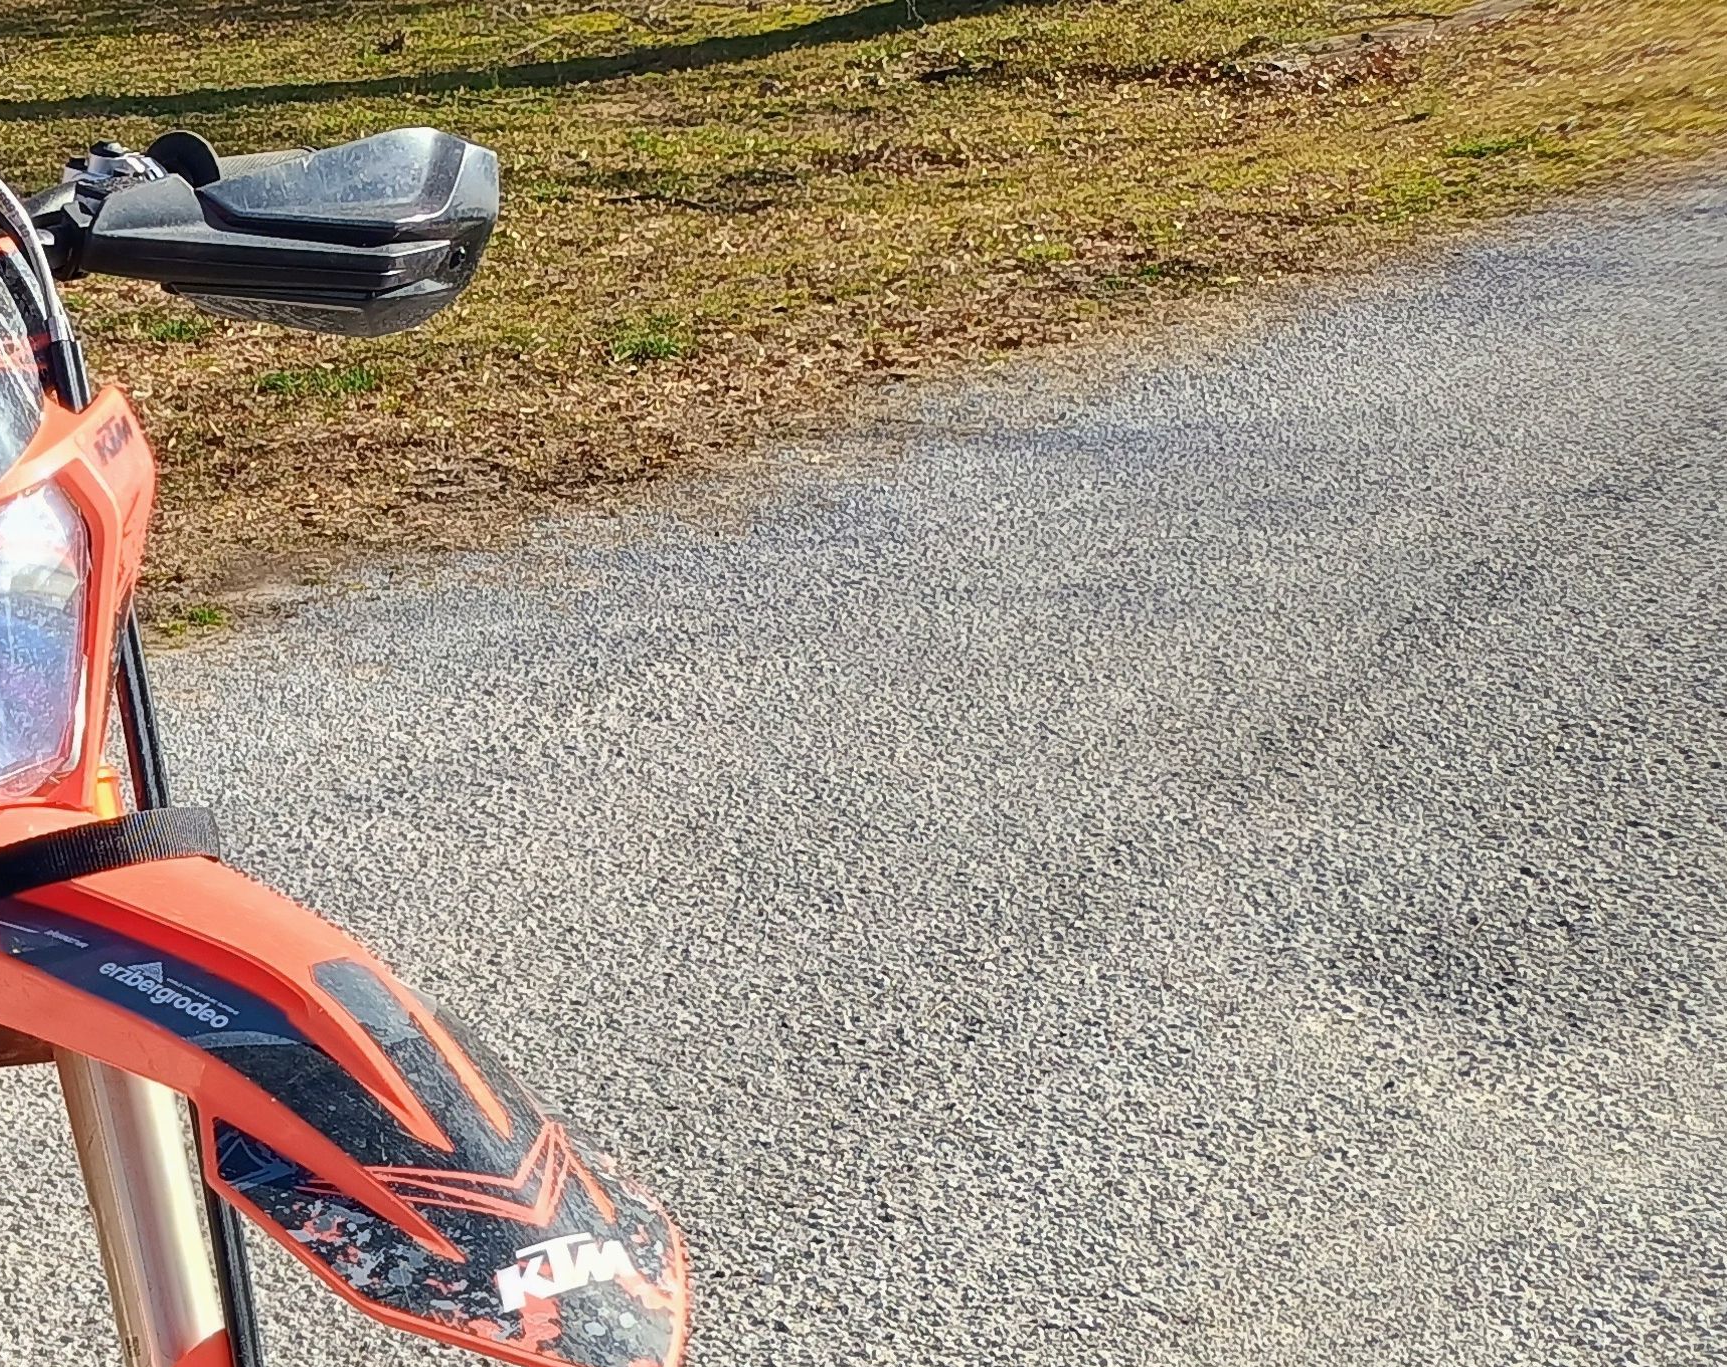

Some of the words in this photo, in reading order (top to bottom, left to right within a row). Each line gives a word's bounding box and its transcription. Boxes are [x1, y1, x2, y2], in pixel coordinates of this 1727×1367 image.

[93, 415, 134, 466] KTM
[99, 961, 229, 1028] erzbergrodeo
[494, 1232, 639, 1313] KTM
